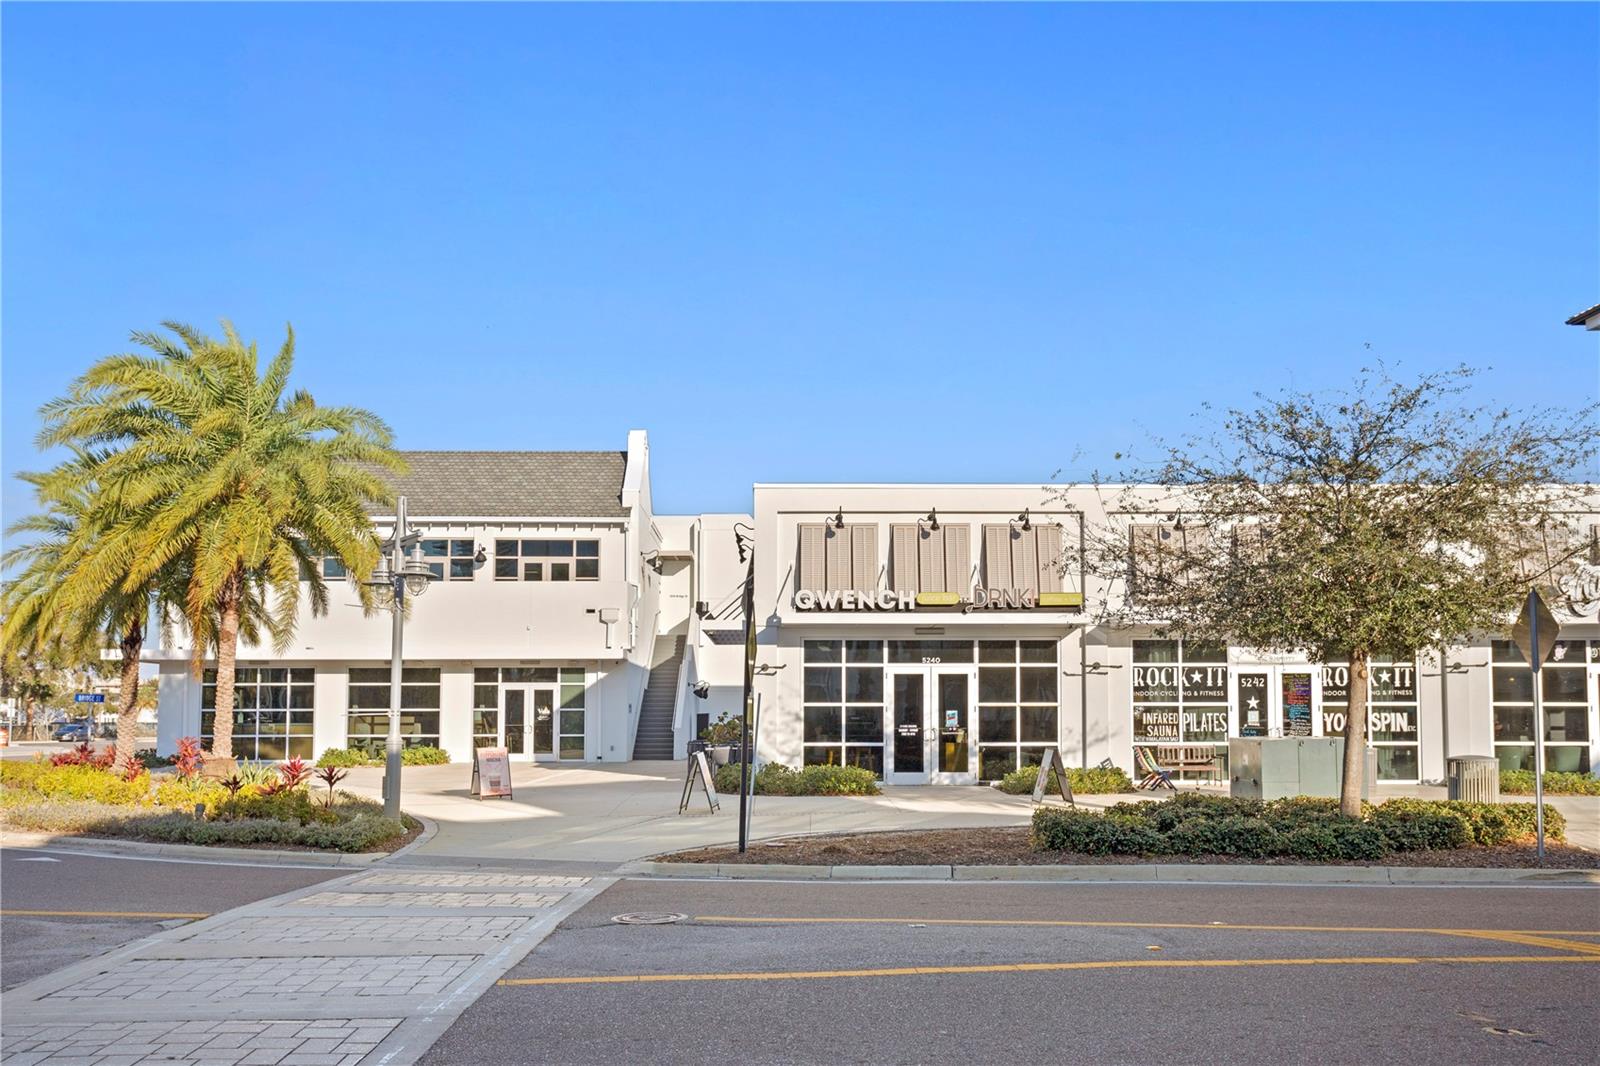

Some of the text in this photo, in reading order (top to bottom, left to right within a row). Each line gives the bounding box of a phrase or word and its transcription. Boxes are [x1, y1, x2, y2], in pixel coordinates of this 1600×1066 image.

[795, 589, 915, 610] QWENCH
[1133, 667, 1226, 687] ROCK IT
[1241, 677, 1265, 687] 5242
[1322, 667, 1414, 687] ROK IT
[1142, 712, 1179, 725] INFARED
[1183, 712, 1227, 732] PILATES
[1372, 712, 1408, 732] SPIN
[1146, 725, 1178, 737] SAUNA
